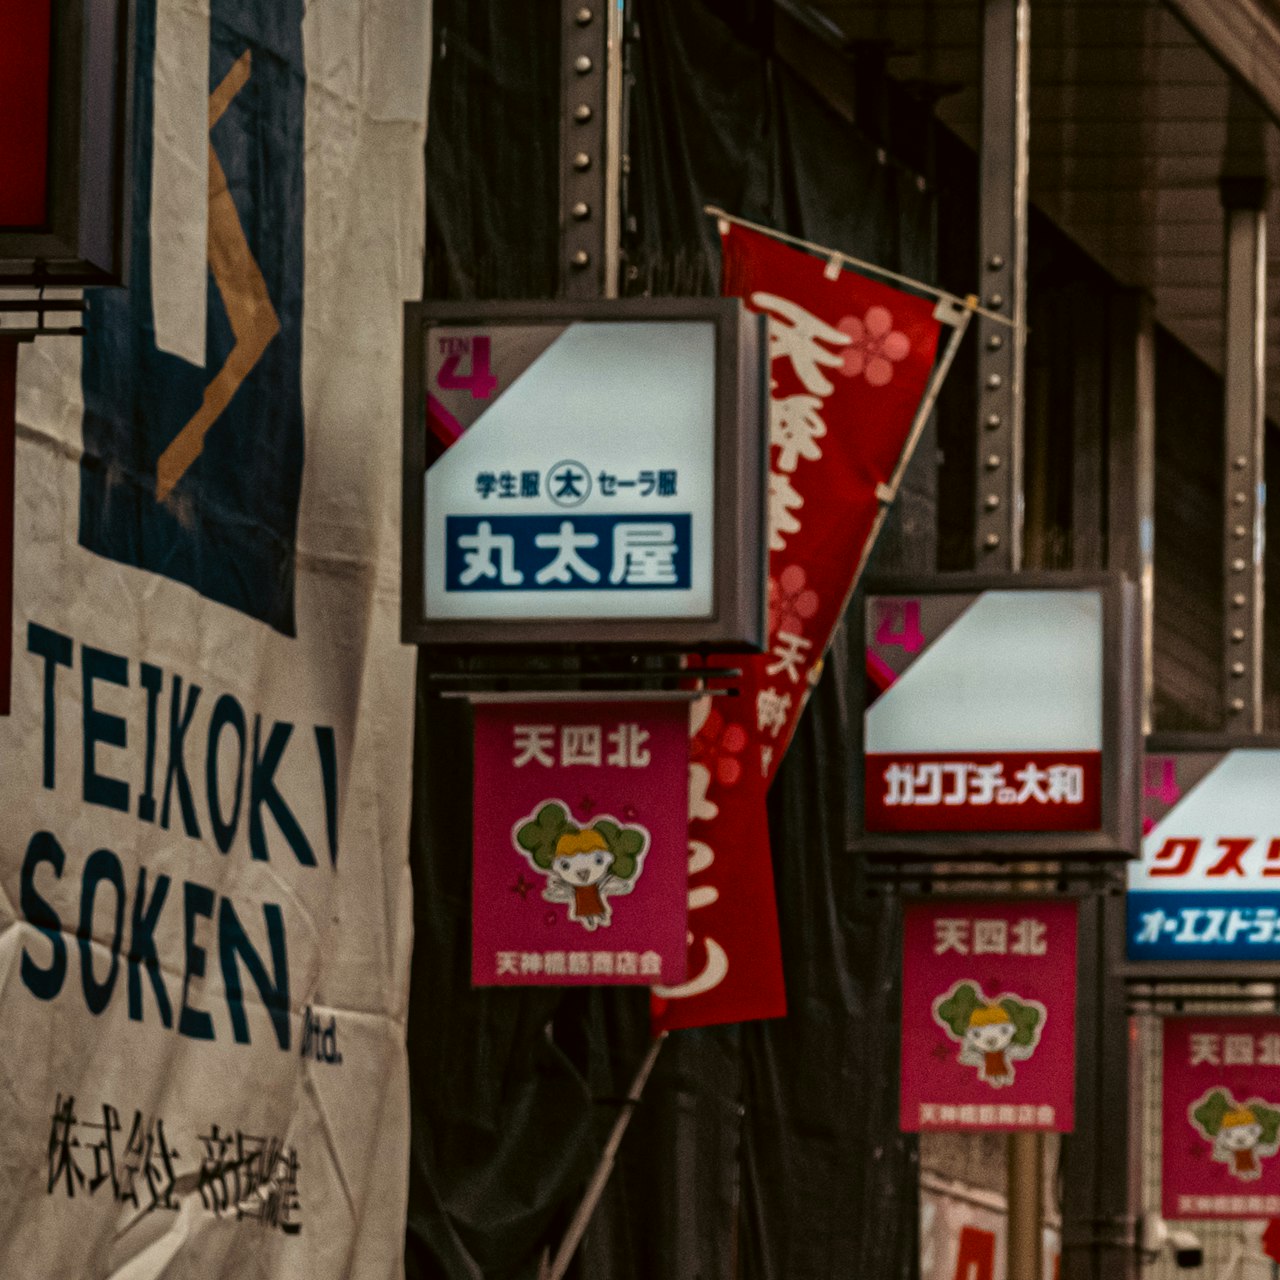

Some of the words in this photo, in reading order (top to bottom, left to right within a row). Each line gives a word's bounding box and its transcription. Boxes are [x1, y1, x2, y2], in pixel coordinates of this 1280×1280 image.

[437, 336, 497, 399] 4
[476, 470, 540, 498] 学生服
[598, 470, 678, 498] セーラ服
[458, 523, 679, 587] 丸太屋
[27, 621, 339, 872] TEIKOKI
[512, 722, 651, 768] 天四北
[20, 830, 293, 1052] SOKEN
[933, 918, 1048, 955] 天四北
